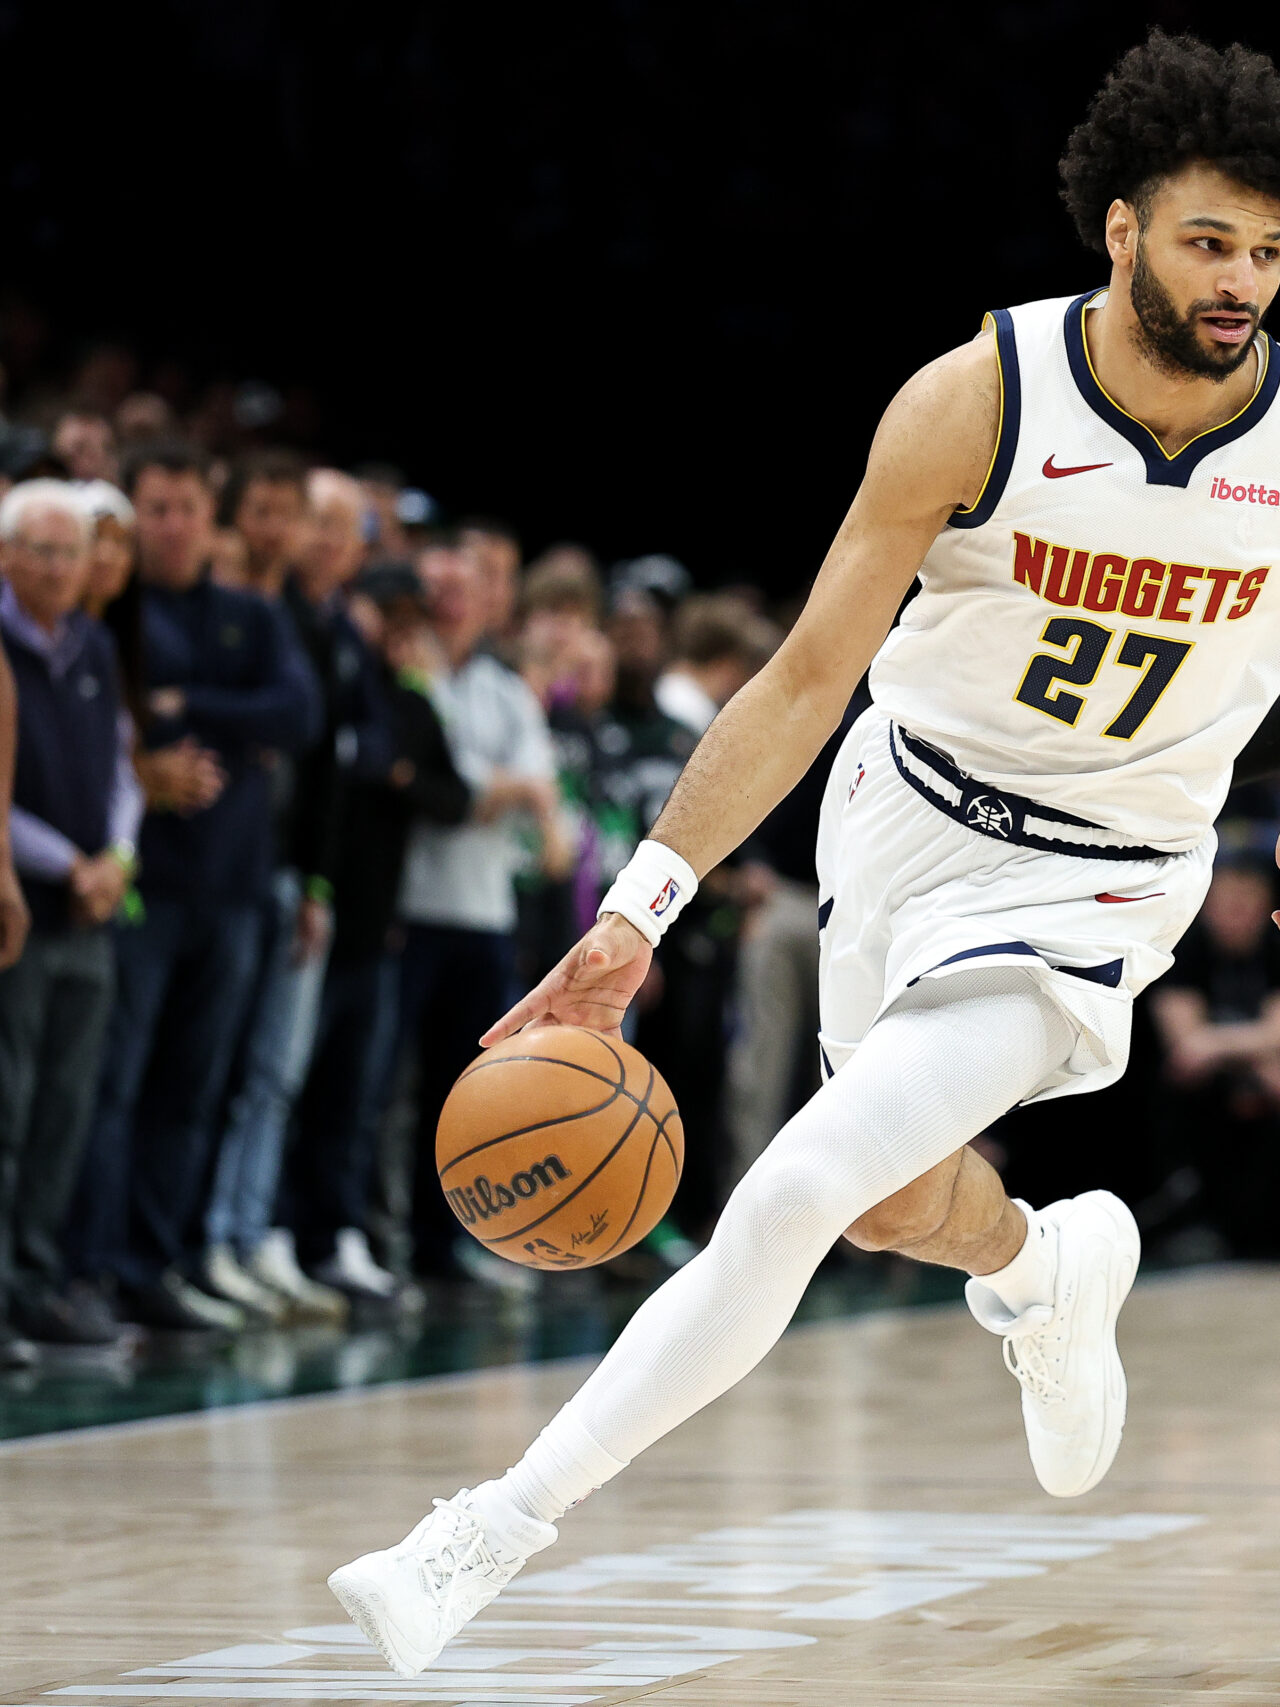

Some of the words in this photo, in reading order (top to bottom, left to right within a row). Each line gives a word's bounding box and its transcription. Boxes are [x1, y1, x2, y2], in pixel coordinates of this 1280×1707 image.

[1209, 477, 1280, 507] ibotta
[1012, 530, 1271, 625] NUGGETS
[1012, 616, 1196, 742] 27
[446, 1154, 573, 1226] Wilson
